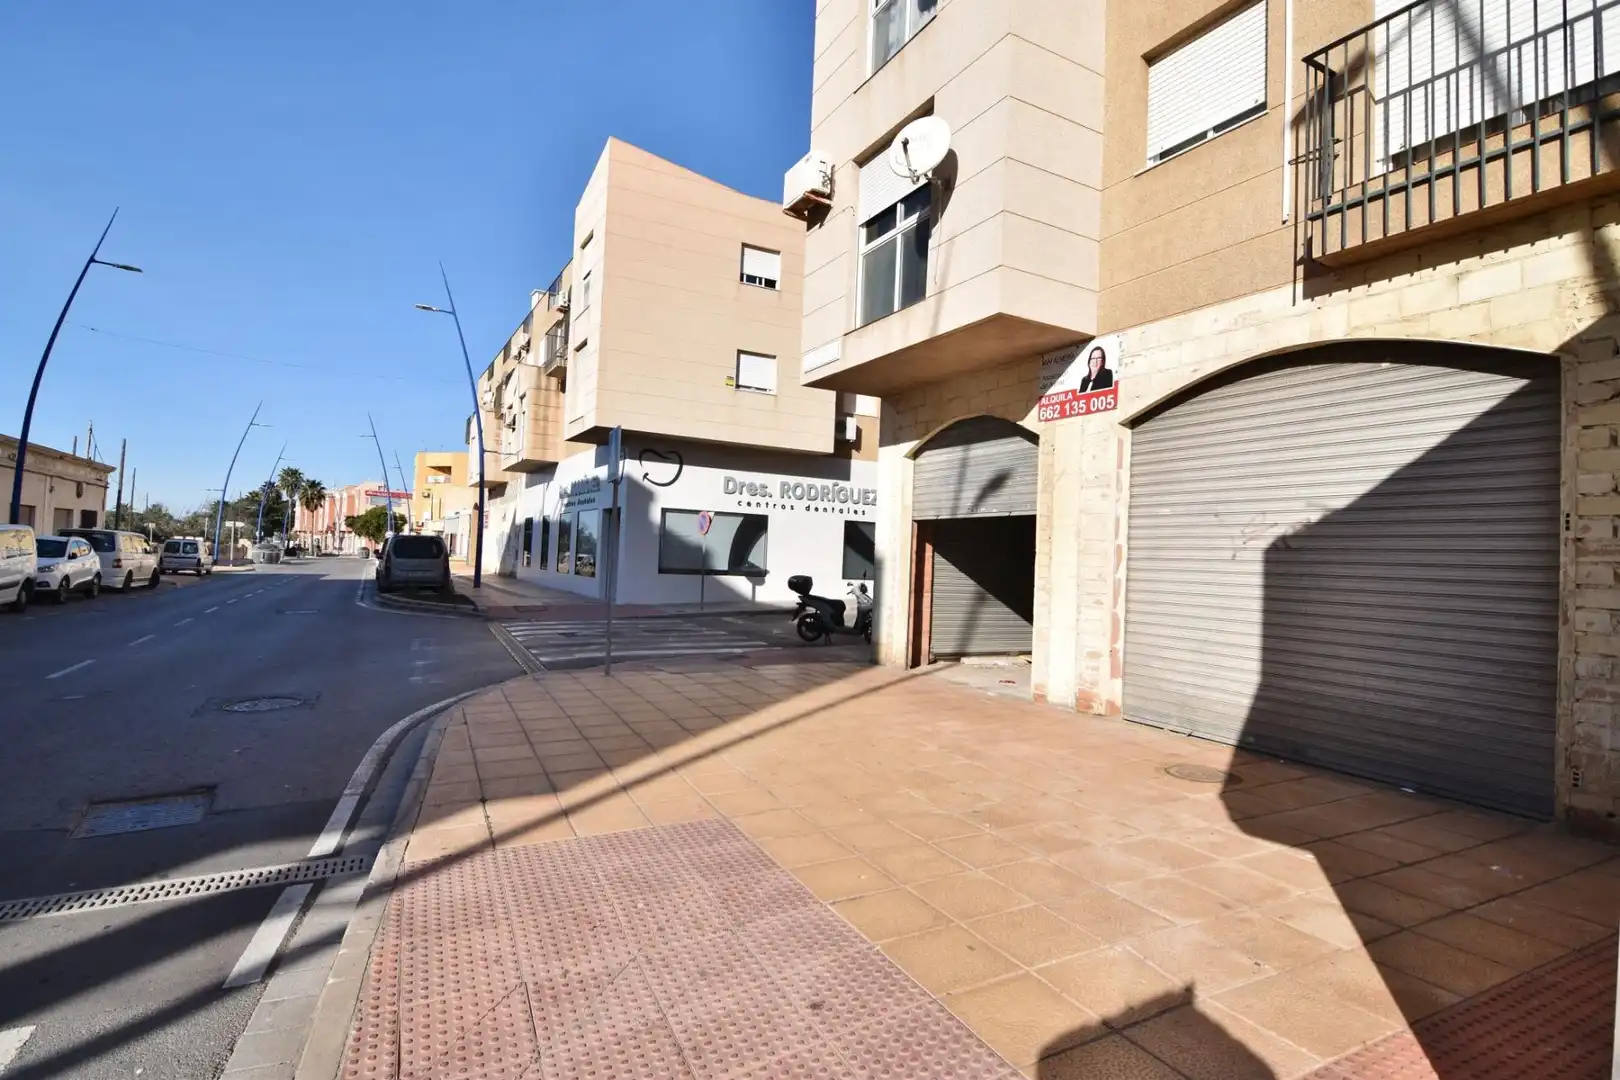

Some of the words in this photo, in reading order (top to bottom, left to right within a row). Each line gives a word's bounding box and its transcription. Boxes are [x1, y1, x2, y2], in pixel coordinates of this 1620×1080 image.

[1040, 405, 1060, 420] 662
[1065, 400, 1086, 416] 135
[1090, 395, 1114, 411] 005
[1041, 392, 1072, 405] ALQUILA
[723, 476, 773, 498] Dres.
[779, 480, 878, 506] RODRÍGUEZ
[737, 500, 794, 511] centros
[805, 504, 866, 516] dentales
